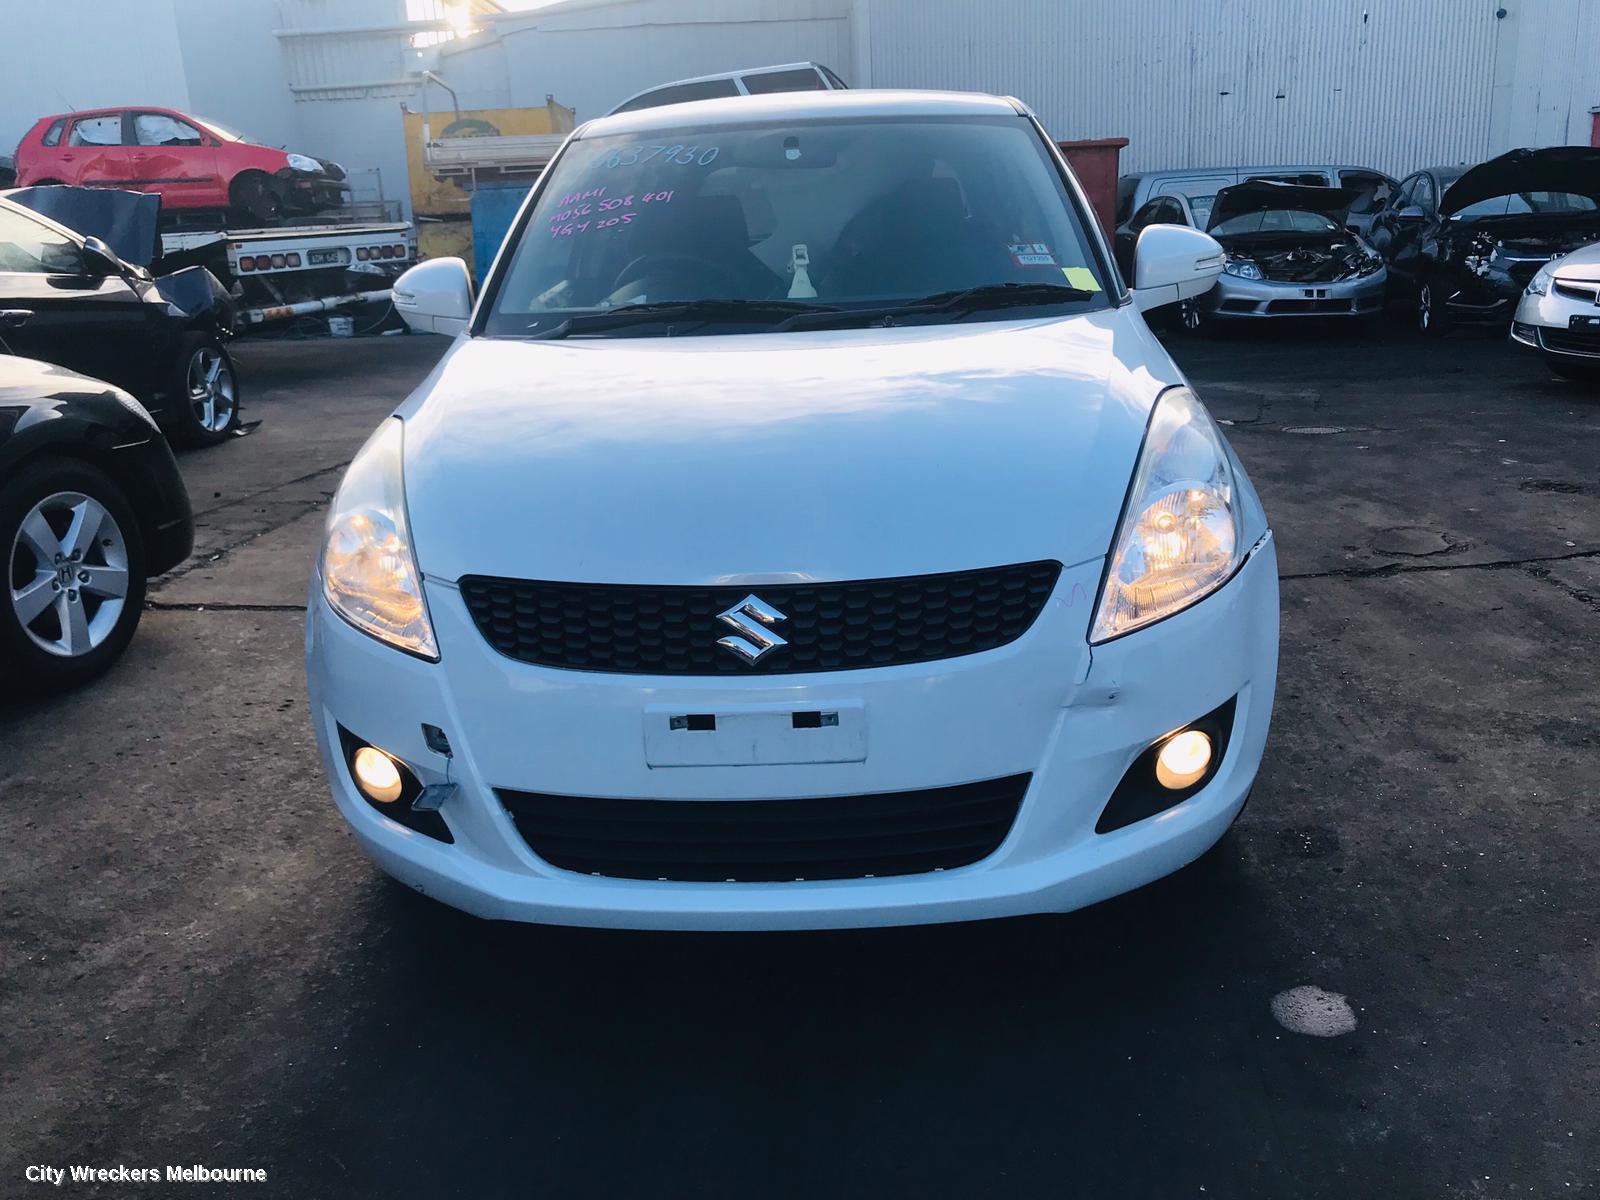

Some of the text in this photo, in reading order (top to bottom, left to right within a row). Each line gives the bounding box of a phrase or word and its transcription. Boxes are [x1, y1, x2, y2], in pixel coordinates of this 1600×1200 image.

[598, 195, 634, 212] 508
[642, 190, 674, 203] 401
[597, 213, 637, 229] 205
